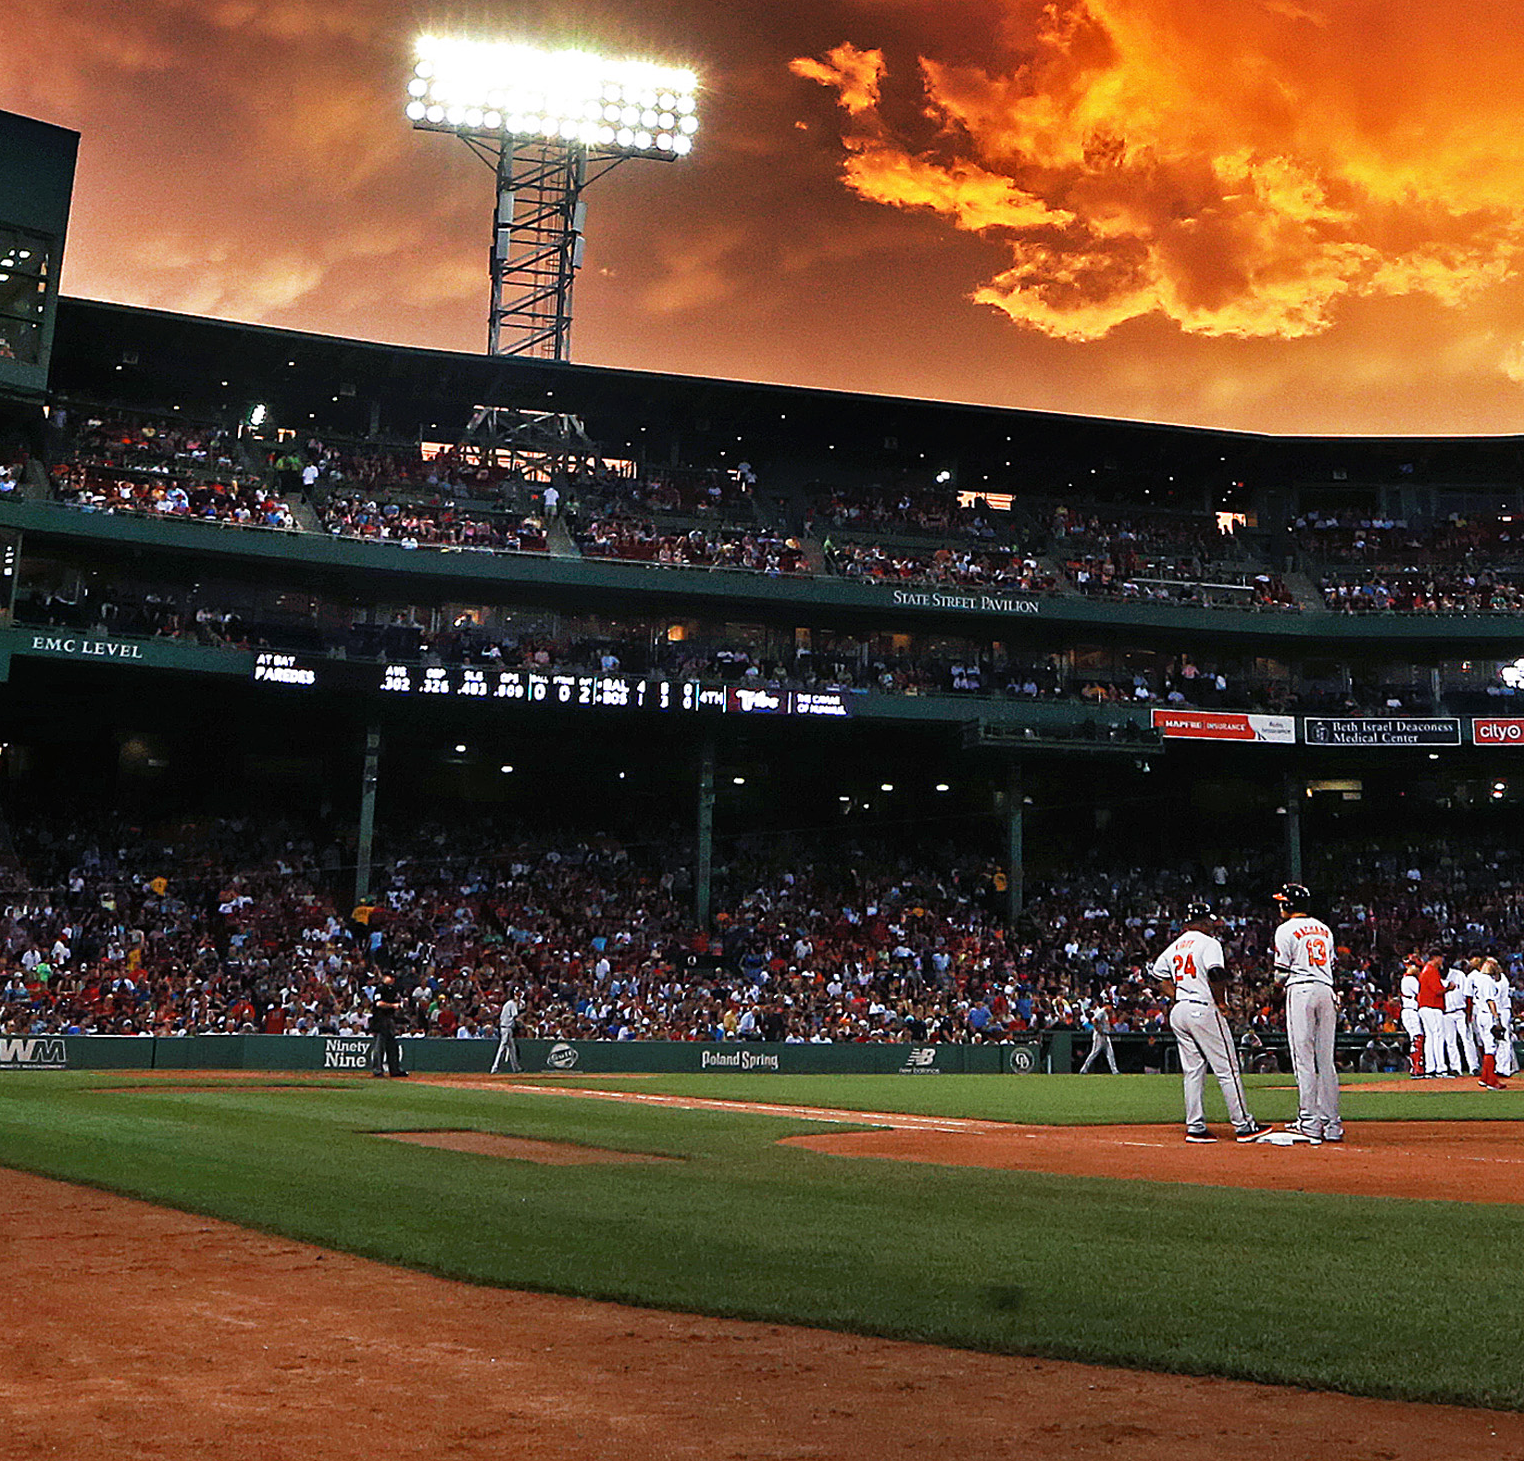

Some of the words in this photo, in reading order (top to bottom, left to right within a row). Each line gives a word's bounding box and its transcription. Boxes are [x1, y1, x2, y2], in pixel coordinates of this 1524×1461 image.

[893, 590, 931, 606] STATE
[932, 593, 977, 610] STREET
[981, 596, 1040, 614] PAVILION
[32, 636, 77, 653] EMC
[81, 641, 144, 659] LEVEL
[256, 653, 272, 666] AT
[273, 654, 296, 667] BAT
[380, 676, 410, 691] .302
[533, 683, 547, 701] 0
[559, 684, 571, 702] 0
[578, 686, 591, 704] 2
[698, 691, 724, 705] 4TH
[1206, 723, 1246, 732] INSURANCE
[1332, 721, 1358, 733] Beth
[1362, 721, 1393, 733] Israel
[1396, 721, 1454, 733] Deaconess
[1333, 732, 1377, 744] Medical
[1381, 732, 1419, 744] Center
[1305, 938, 1328, 968] 13
[1172, 951, 1197, 982] 24
[325, 1039, 371, 1055] Ninety
[324, 1052, 367, 1068] Nine
[701, 1049, 741, 1069] Poland
[741, 1050, 779, 1070] Spring
